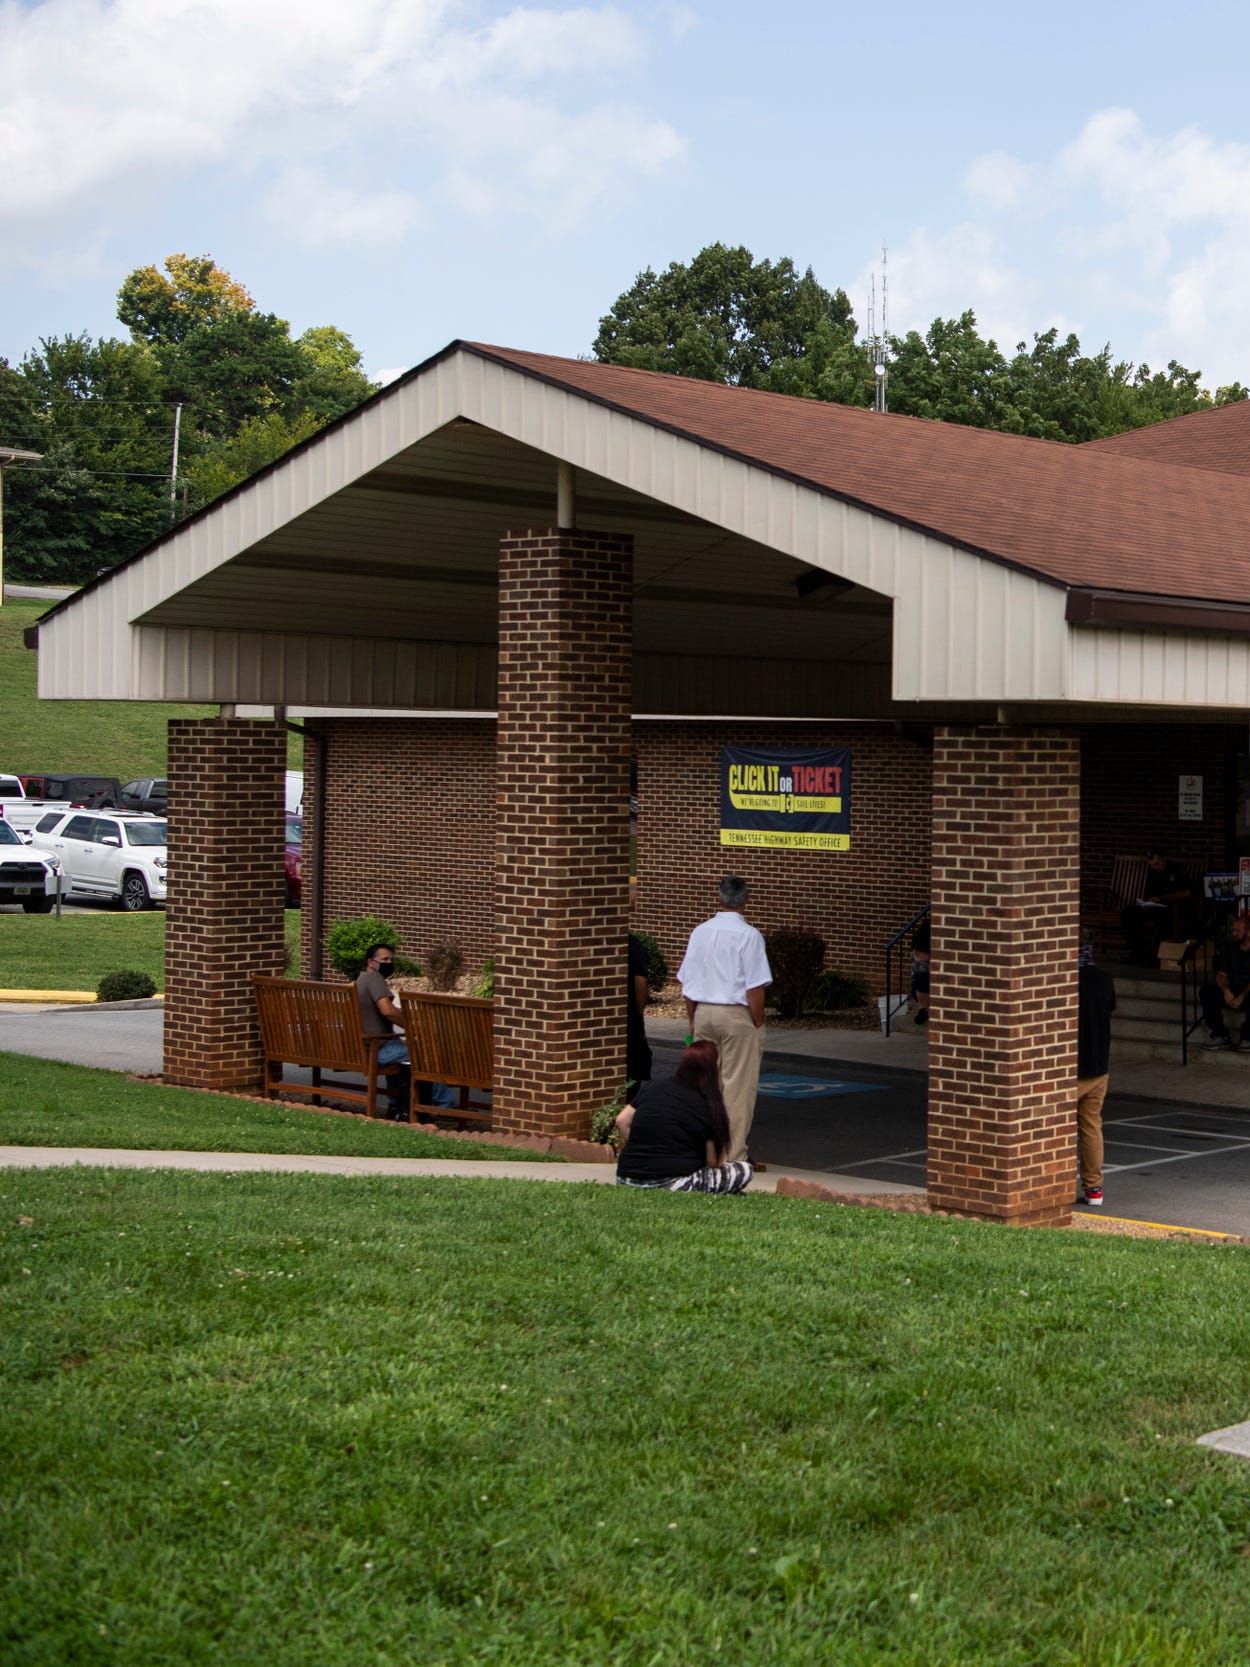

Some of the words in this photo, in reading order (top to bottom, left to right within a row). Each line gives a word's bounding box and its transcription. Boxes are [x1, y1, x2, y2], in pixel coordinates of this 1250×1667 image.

[729, 765, 766, 791] CLICK
[767, 766, 779, 791] IT
[779, 777, 793, 792] OR
[792, 766, 842, 793] TICKET
[729, 833, 762, 844] TENNESSEE
[764, 835, 792, 846] HIGHWAY
[793, 836, 818, 847] SAFETY
[819, 838, 841, 848] OFFICE
